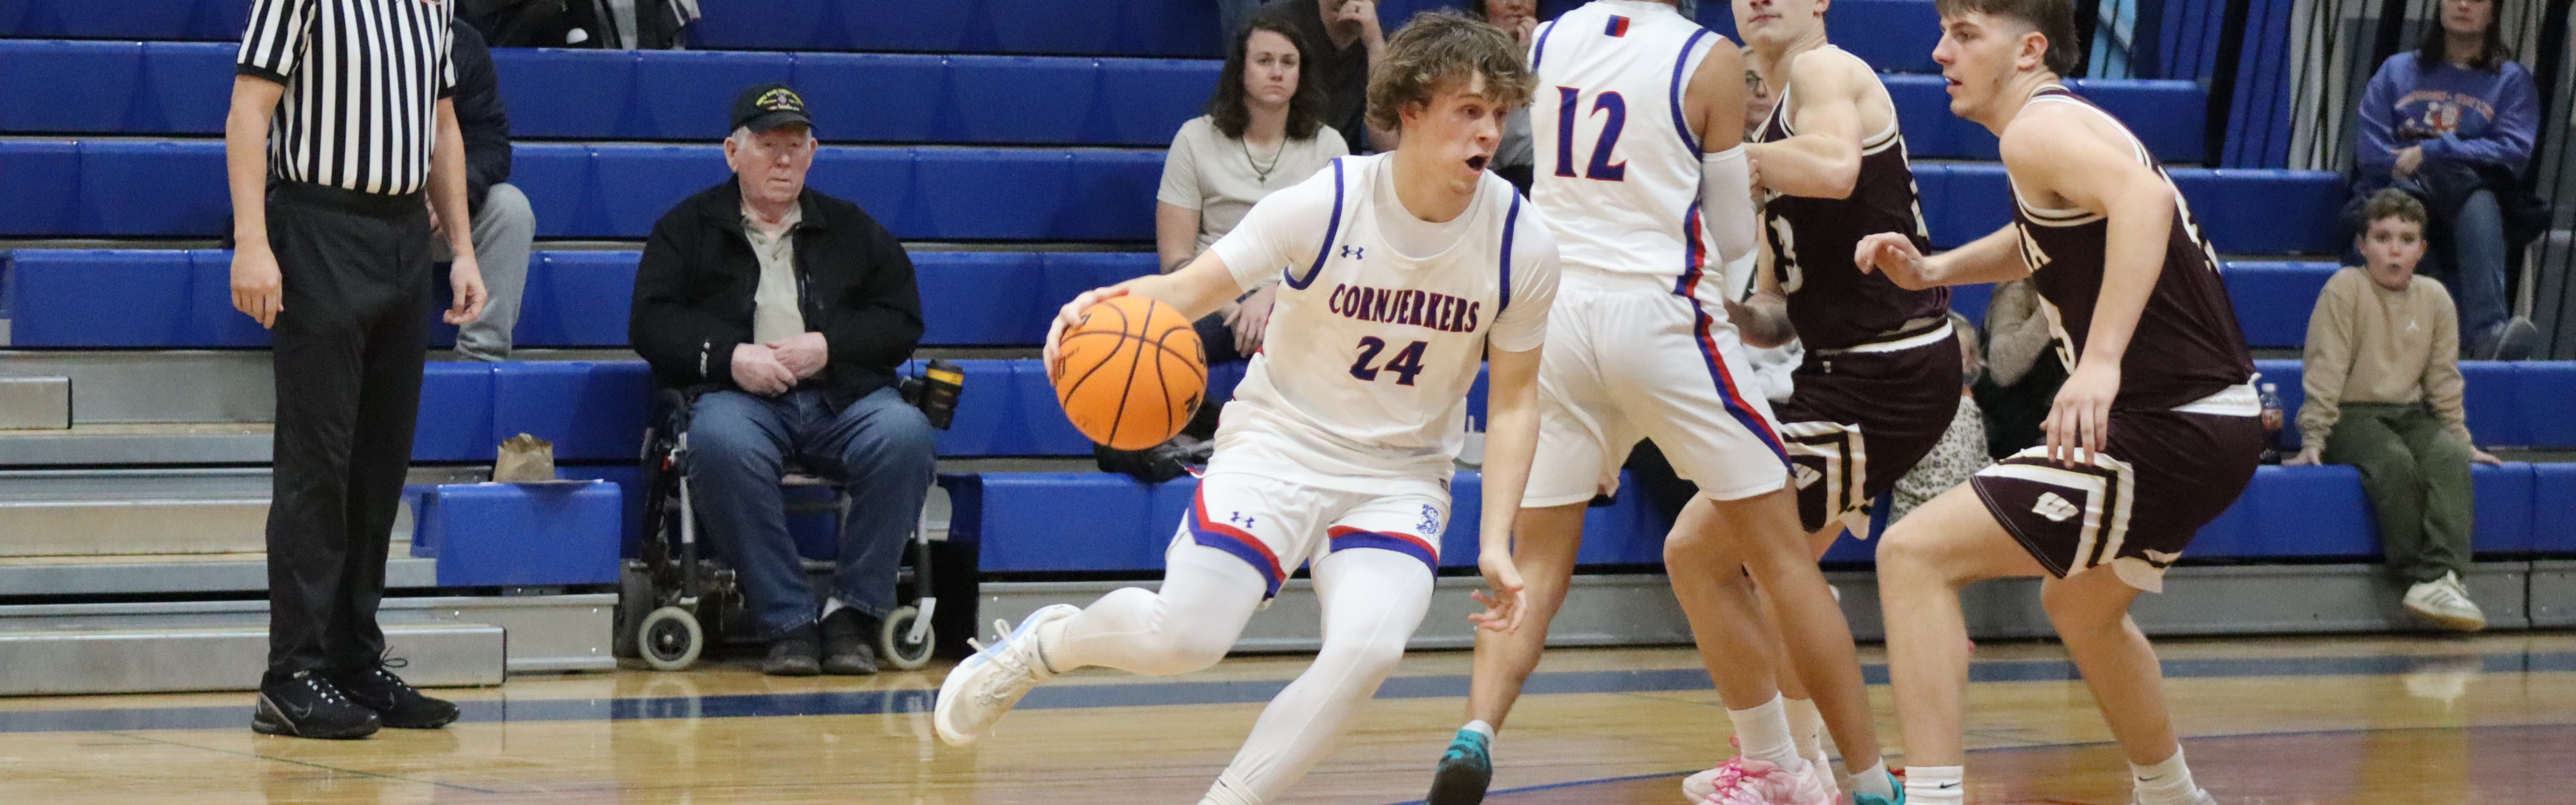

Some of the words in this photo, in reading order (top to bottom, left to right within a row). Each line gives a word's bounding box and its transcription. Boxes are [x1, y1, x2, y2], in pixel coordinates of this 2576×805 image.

[1555, 86, 1628, 182] 12
[1329, 283, 1480, 333] CORNJERKERS
[1349, 336, 1428, 386] 24
